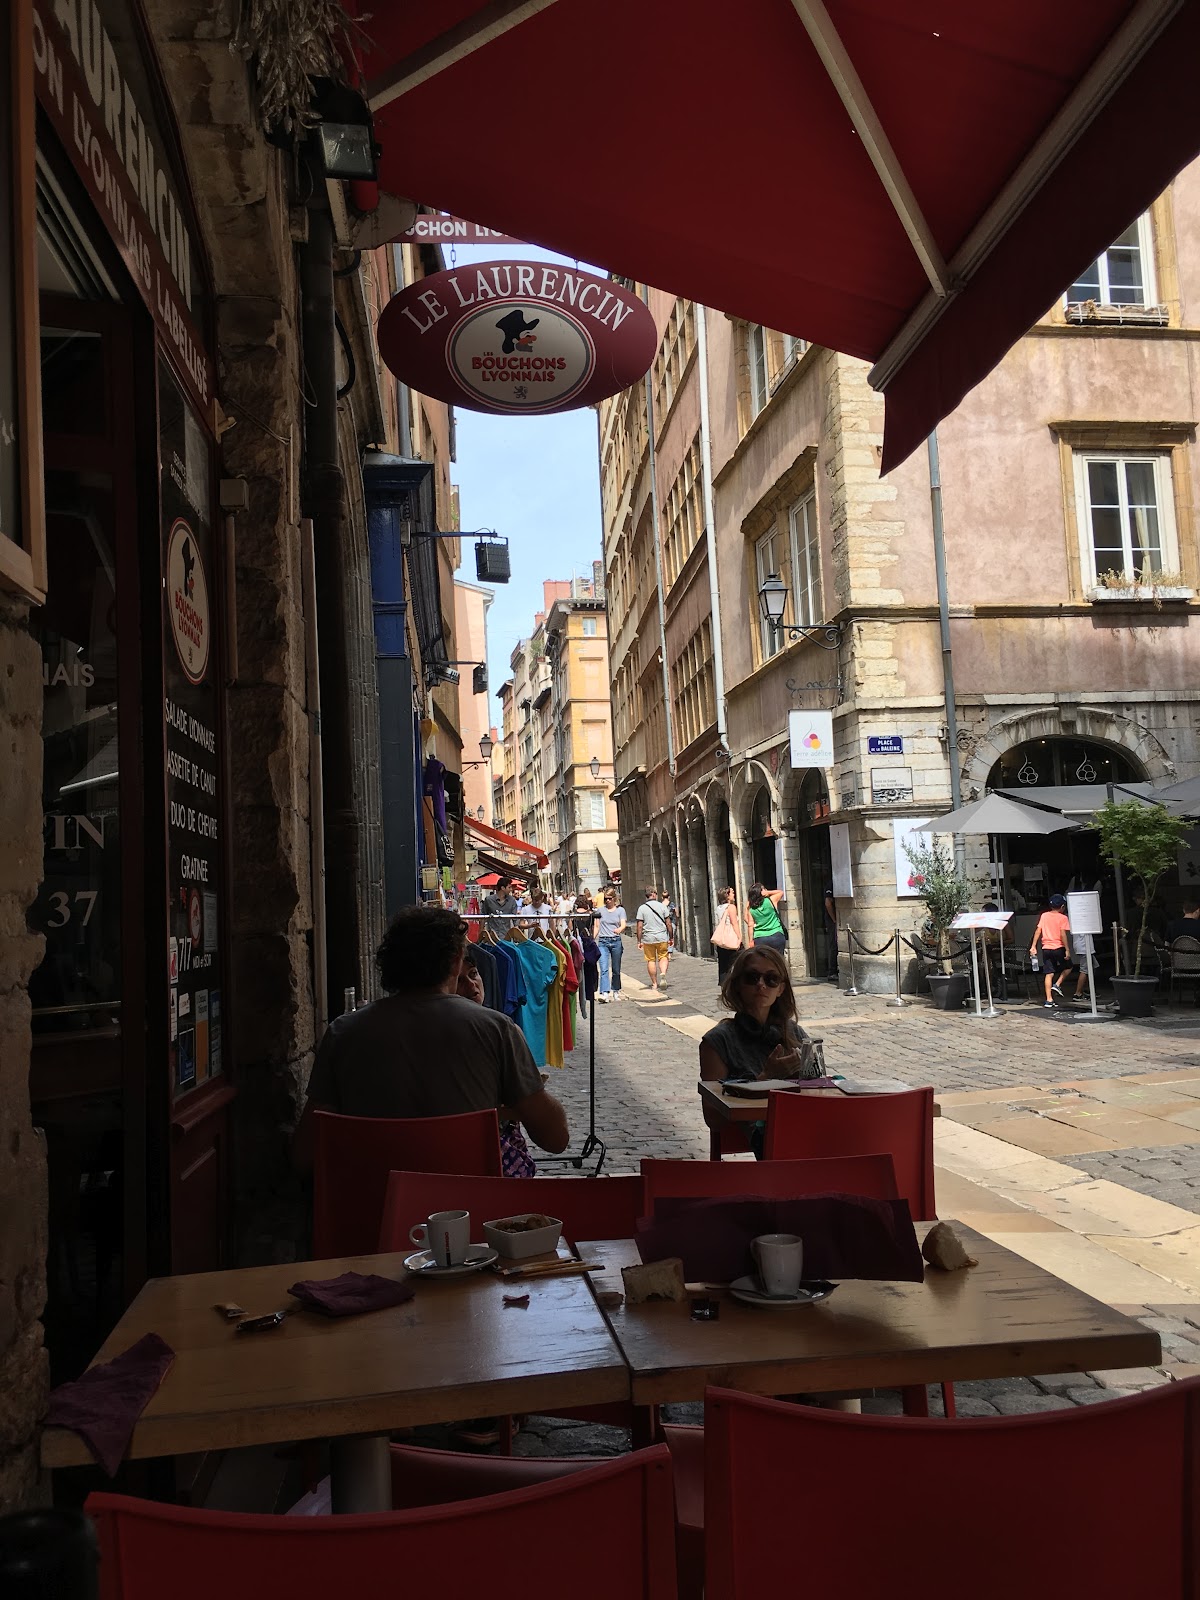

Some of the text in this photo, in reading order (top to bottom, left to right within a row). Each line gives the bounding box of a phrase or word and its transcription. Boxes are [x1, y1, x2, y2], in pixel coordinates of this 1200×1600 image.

[73, 91, 153, 291] LYONNAIS
[156, 268, 210, 405] LABELLISÉ
[401, 265, 634, 335] LE LAURENCIN
[471, 356, 567, 370] BOUCHONS
[482, 370, 556, 382] LYONNAIS
[175, 590, 203, 635] BOUCHONS
[165, 697, 188, 736] SALADE
[192, 761, 199, 788] DE
[200, 766, 217, 796] CANUT
[44, 814, 105, 849] IN
[170, 800, 219, 840] DUO DE CHEVRE
[47, 890, 98, 928] 37
[178, 935, 193, 972] 7/7
